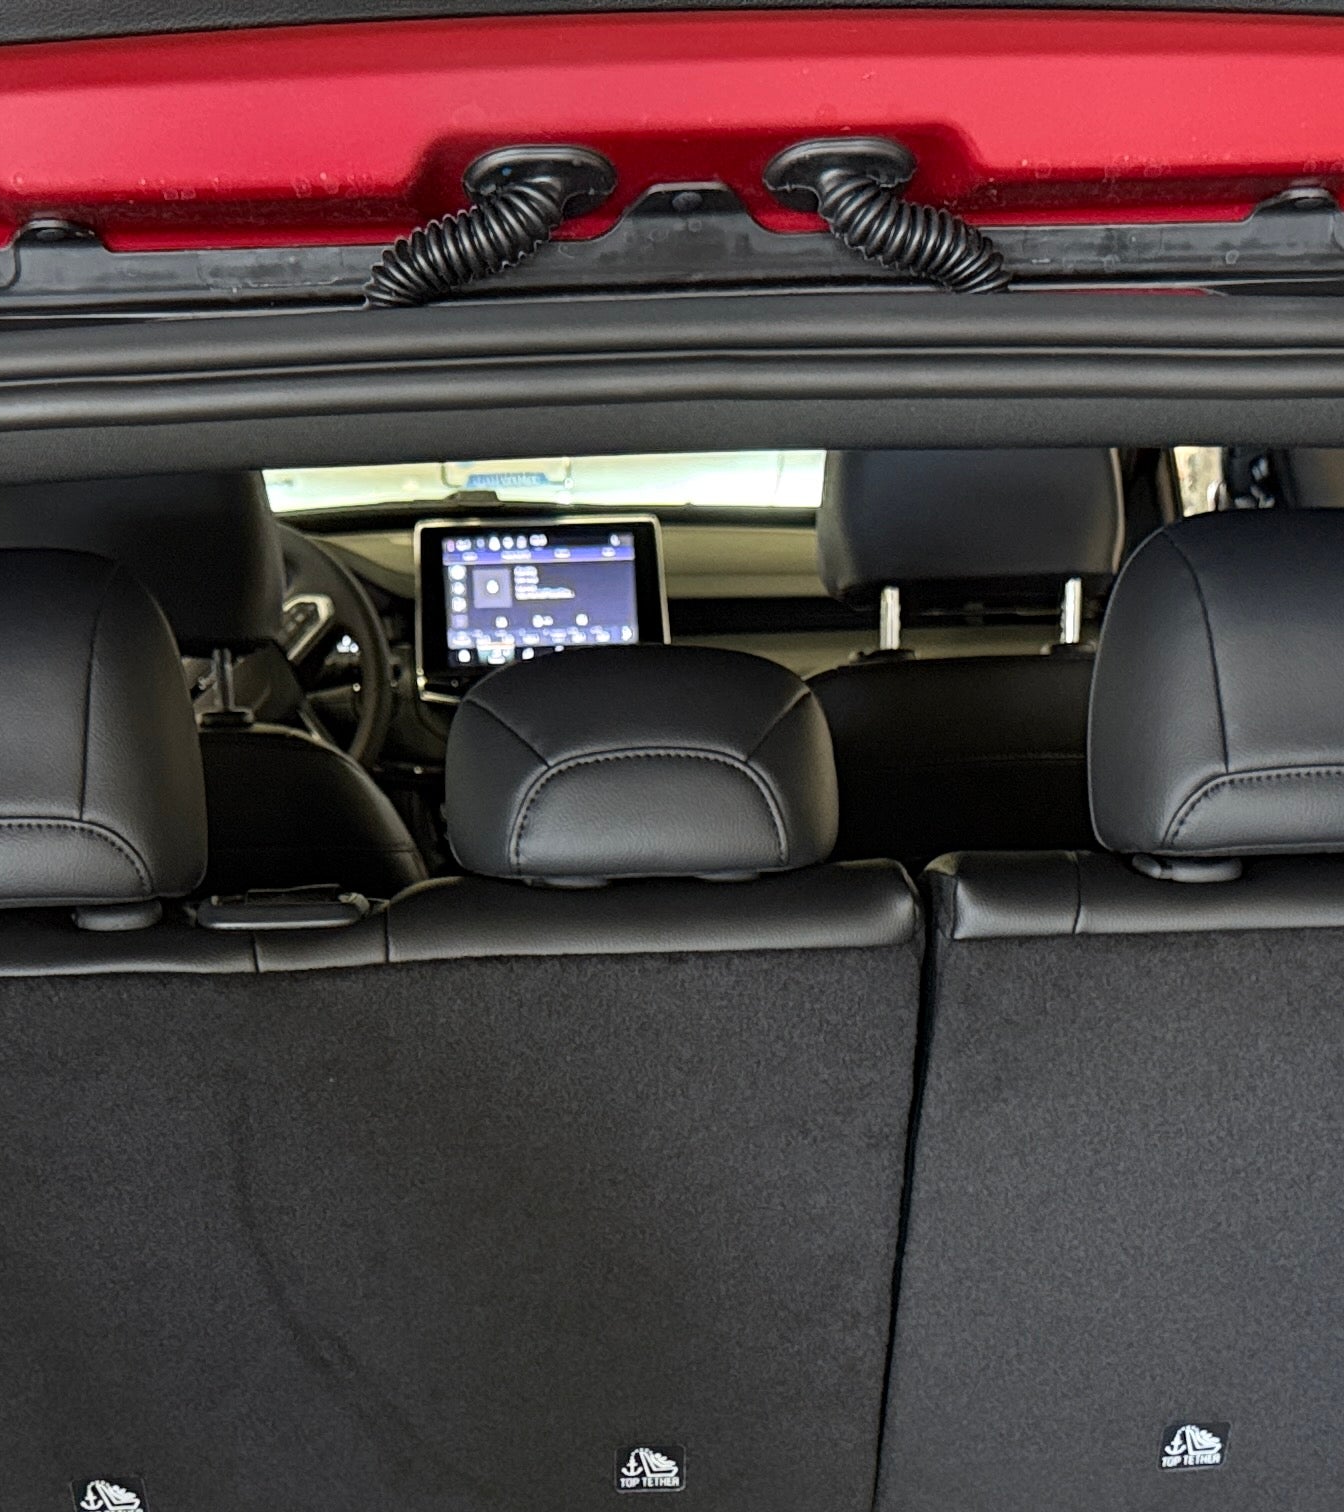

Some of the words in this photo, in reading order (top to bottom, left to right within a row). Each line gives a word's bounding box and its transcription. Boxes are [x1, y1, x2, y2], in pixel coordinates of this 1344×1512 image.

[1161, 1455, 1182, 1468] TOP
[1182, 1453, 1221, 1466] TETHER
[619, 1477, 641, 1488] TOP
[641, 1476, 680, 1487] TETHER
